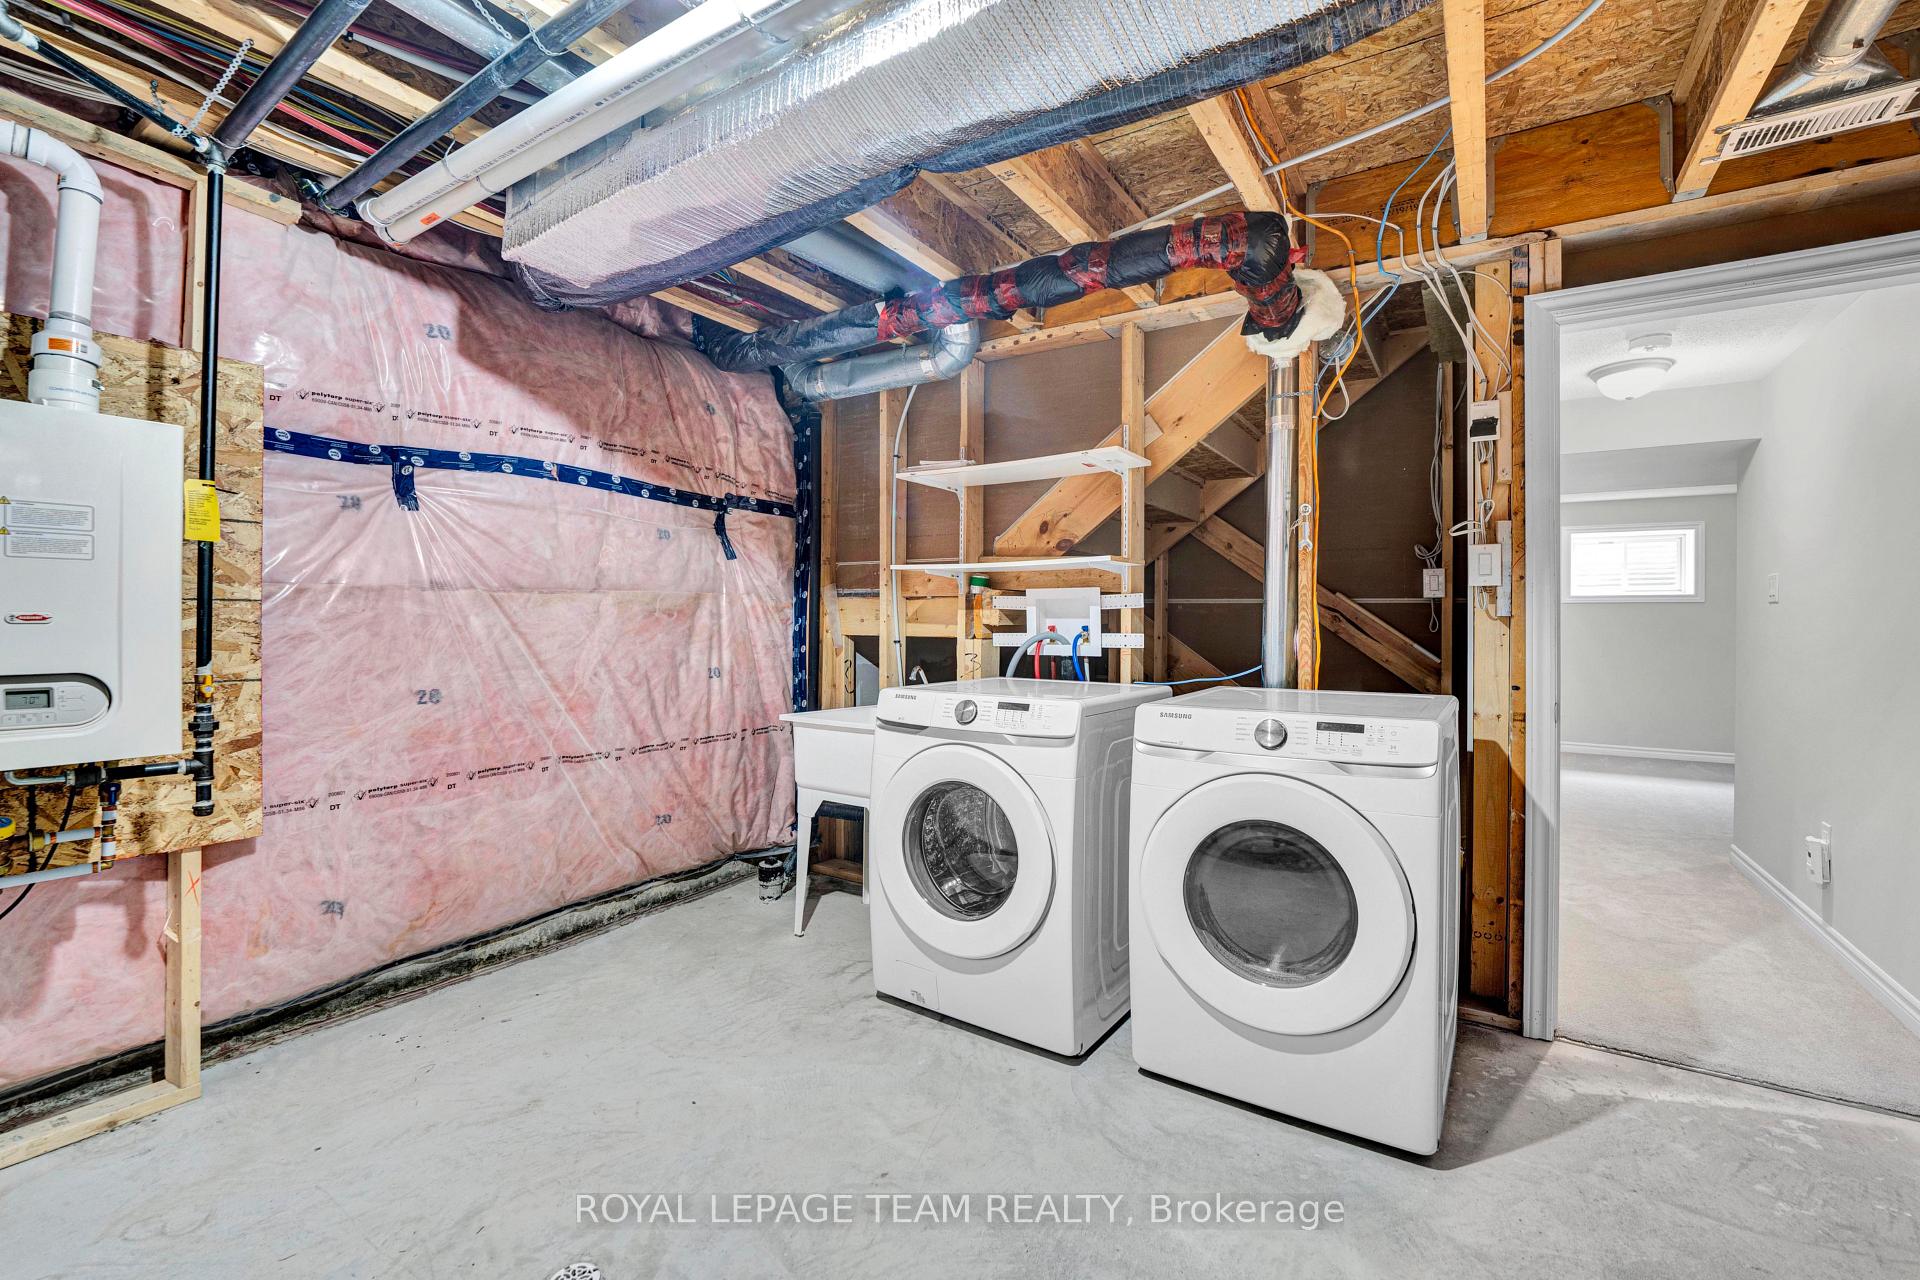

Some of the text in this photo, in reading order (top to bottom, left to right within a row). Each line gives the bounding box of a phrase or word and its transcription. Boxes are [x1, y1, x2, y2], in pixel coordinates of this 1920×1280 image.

[269, 394, 282, 402] DT
[895, 693, 917, 701] SAMSUNG
[1159, 711, 1192, 720] SAMSUNG
[269, 799, 305, 810] super-six
[329, 803, 341, 811] DT
